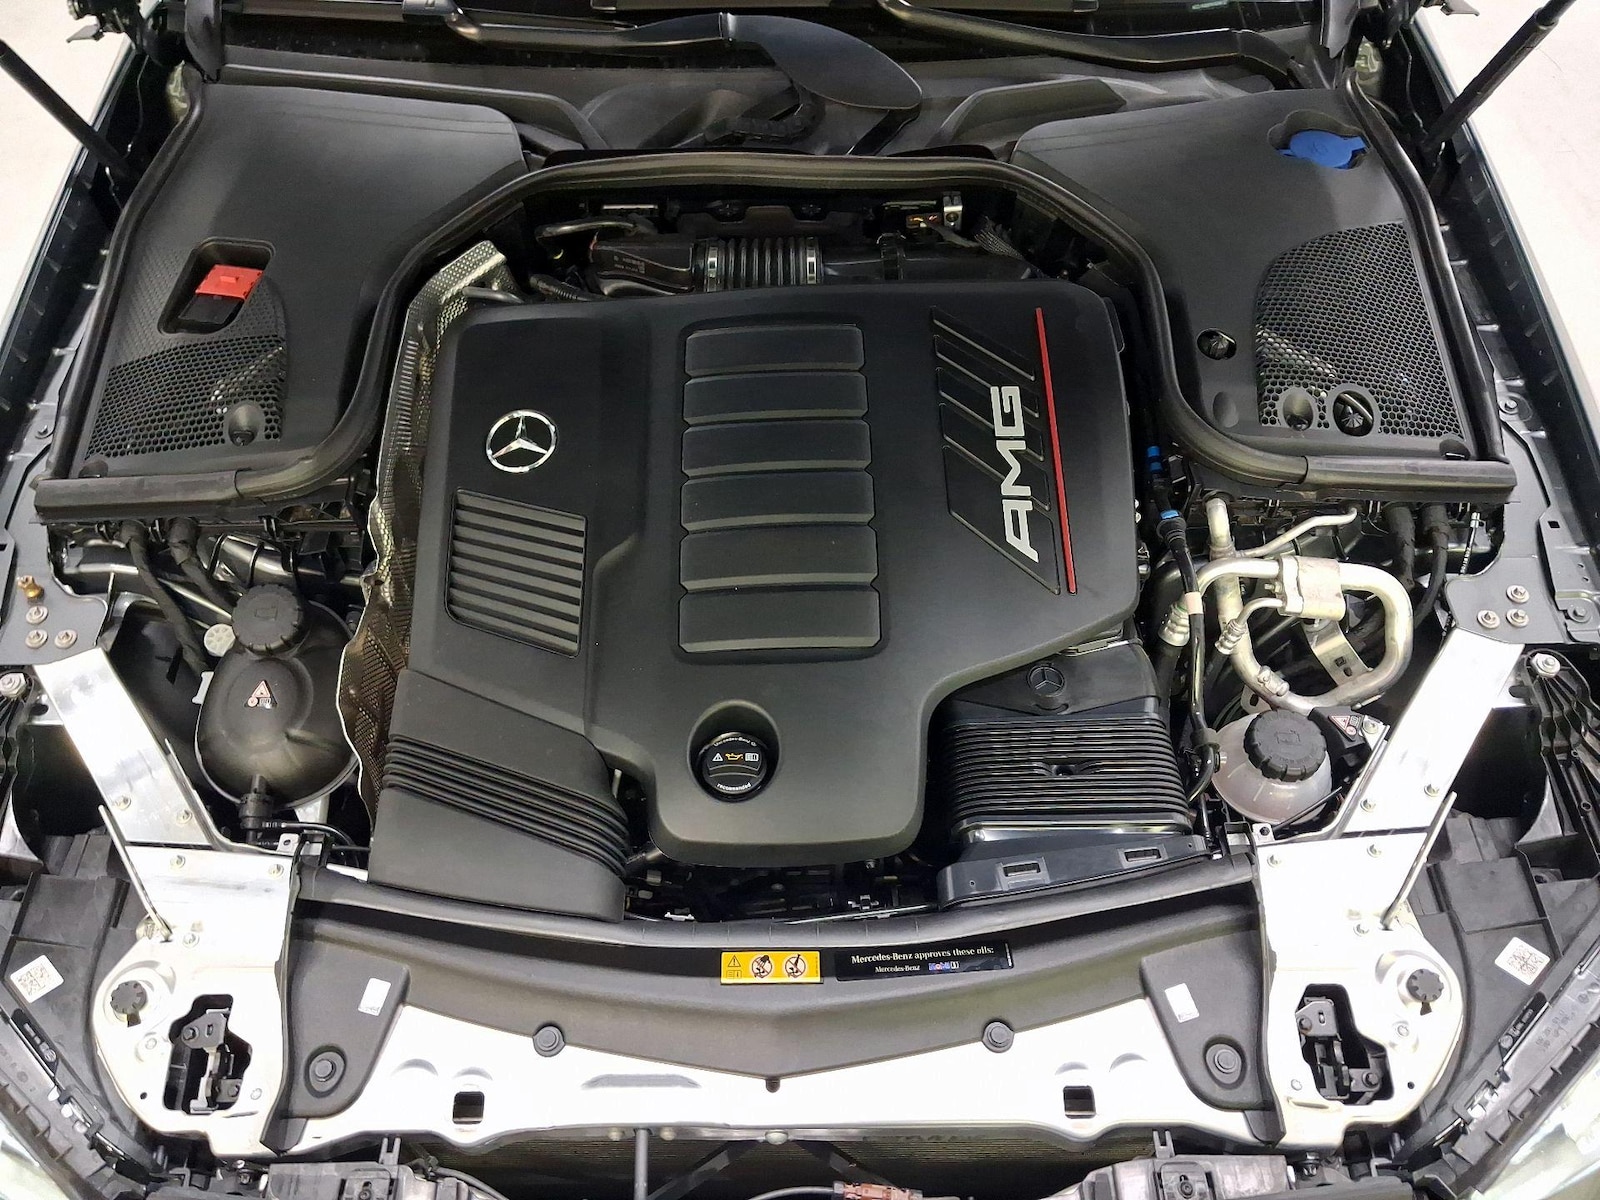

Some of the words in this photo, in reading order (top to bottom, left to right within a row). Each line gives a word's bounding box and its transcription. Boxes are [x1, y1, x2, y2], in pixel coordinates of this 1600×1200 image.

[990, 386, 1039, 563] AMG
[851, 952, 913, 964] Mercedes-Benz
[914, 949, 951, 960] approves
[952, 947, 975, 956] these
[976, 945, 995, 955] oils:
[875, 964, 921, 973] Mercedes-Benz
